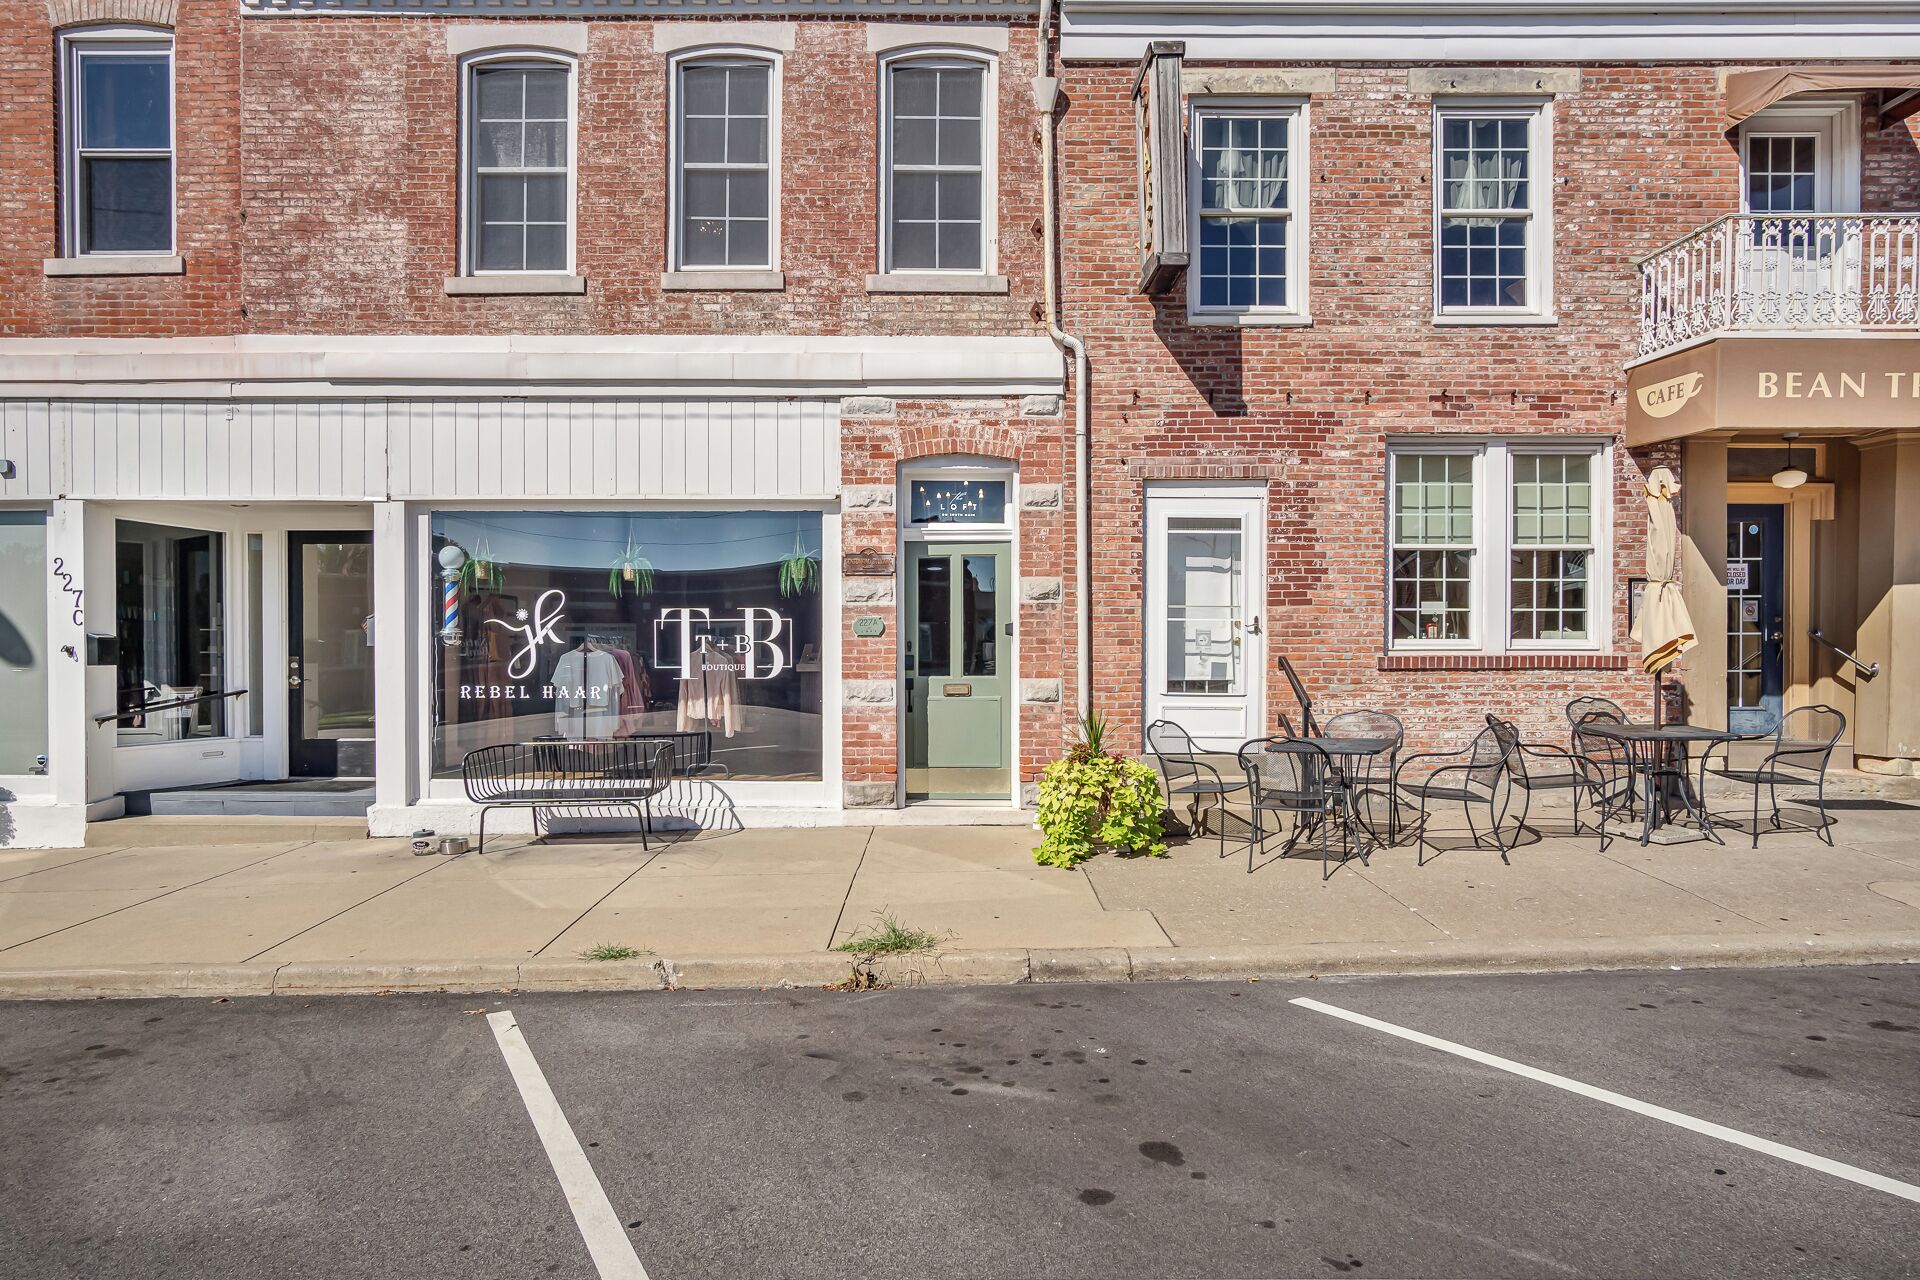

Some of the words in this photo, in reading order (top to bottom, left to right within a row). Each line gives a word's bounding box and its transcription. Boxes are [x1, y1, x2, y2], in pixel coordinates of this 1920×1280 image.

[1646, 382, 1685, 407] CAFE
[1758, 372, 1866, 398] BEAN
[701, 663, 746, 672] BOUTIQUE
[460, 685, 530, 699] REBEL
[542, 685, 601, 699] HAAR
